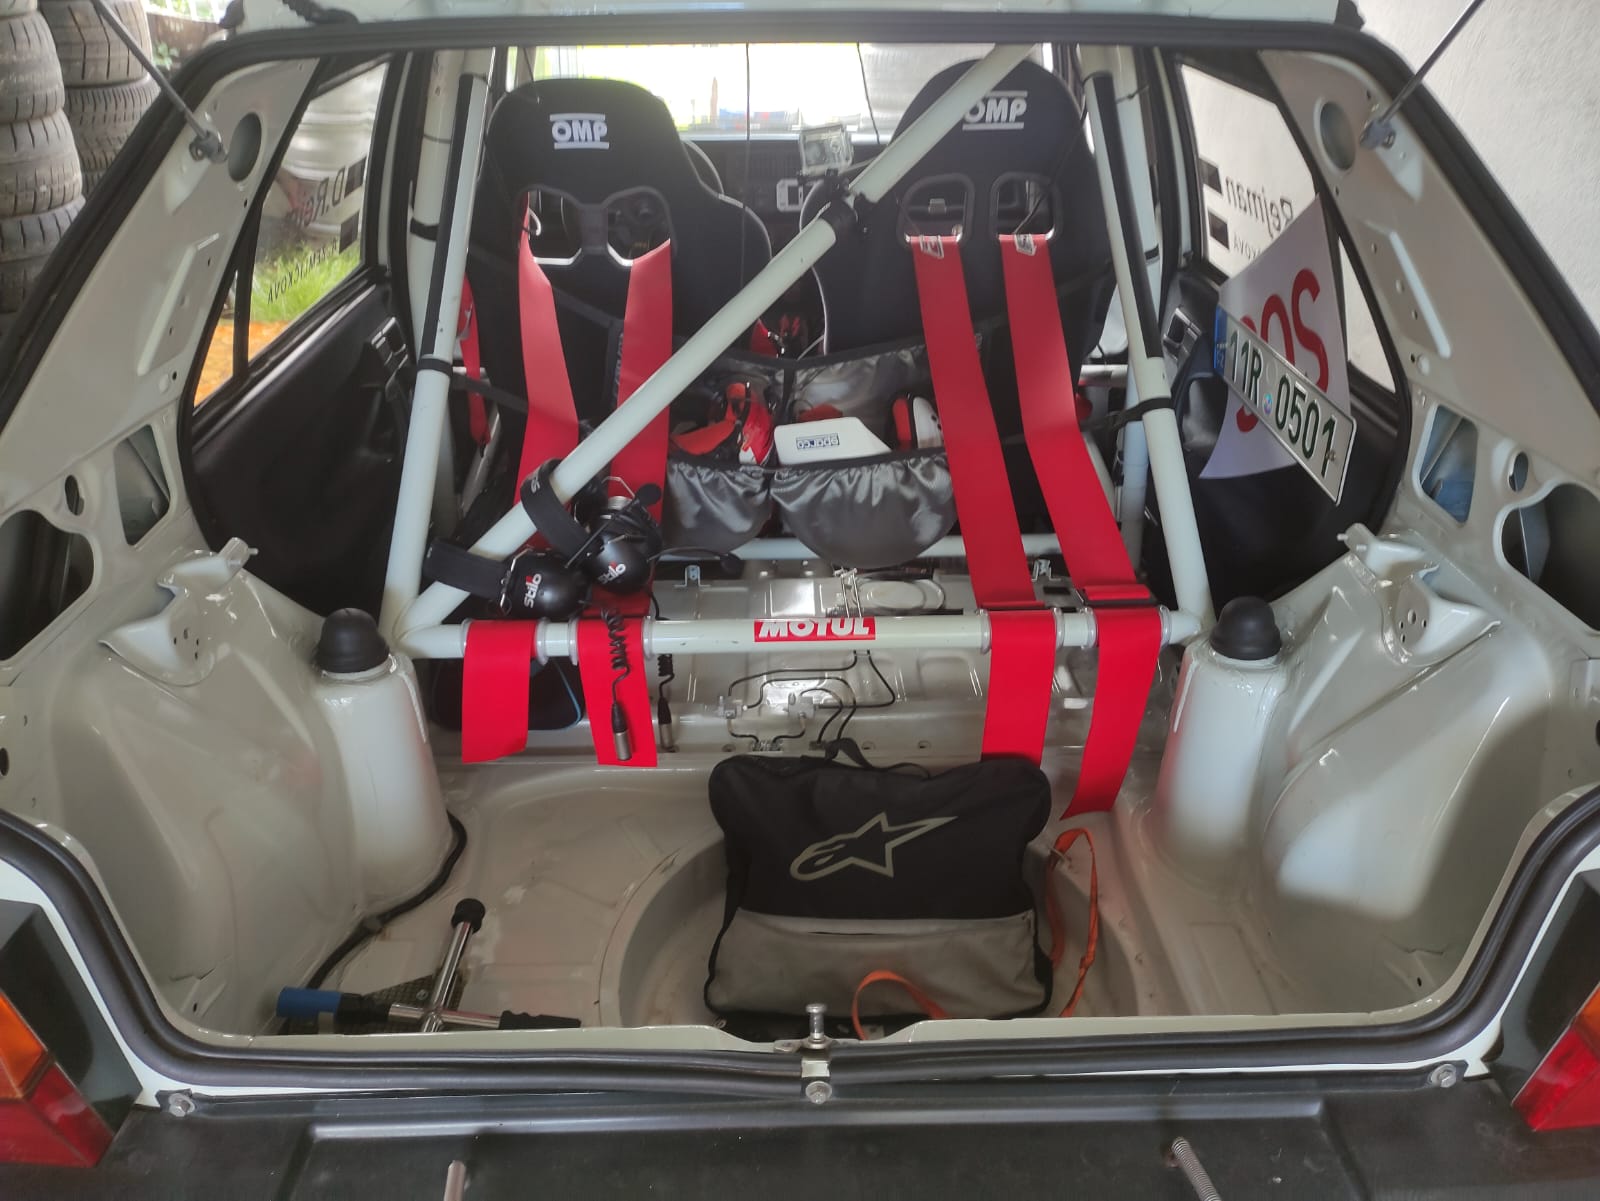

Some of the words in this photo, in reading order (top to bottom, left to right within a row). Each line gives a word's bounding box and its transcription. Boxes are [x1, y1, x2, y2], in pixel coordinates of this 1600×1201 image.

[963, 98, 1027, 123] OMP
[551, 119, 608, 143] OMP
[1230, 329, 1263, 408] 11R
[1274, 373, 1338, 478] 0501
[523, 573, 542, 609] Stilo
[758, 617, 870, 638] MOTUL
